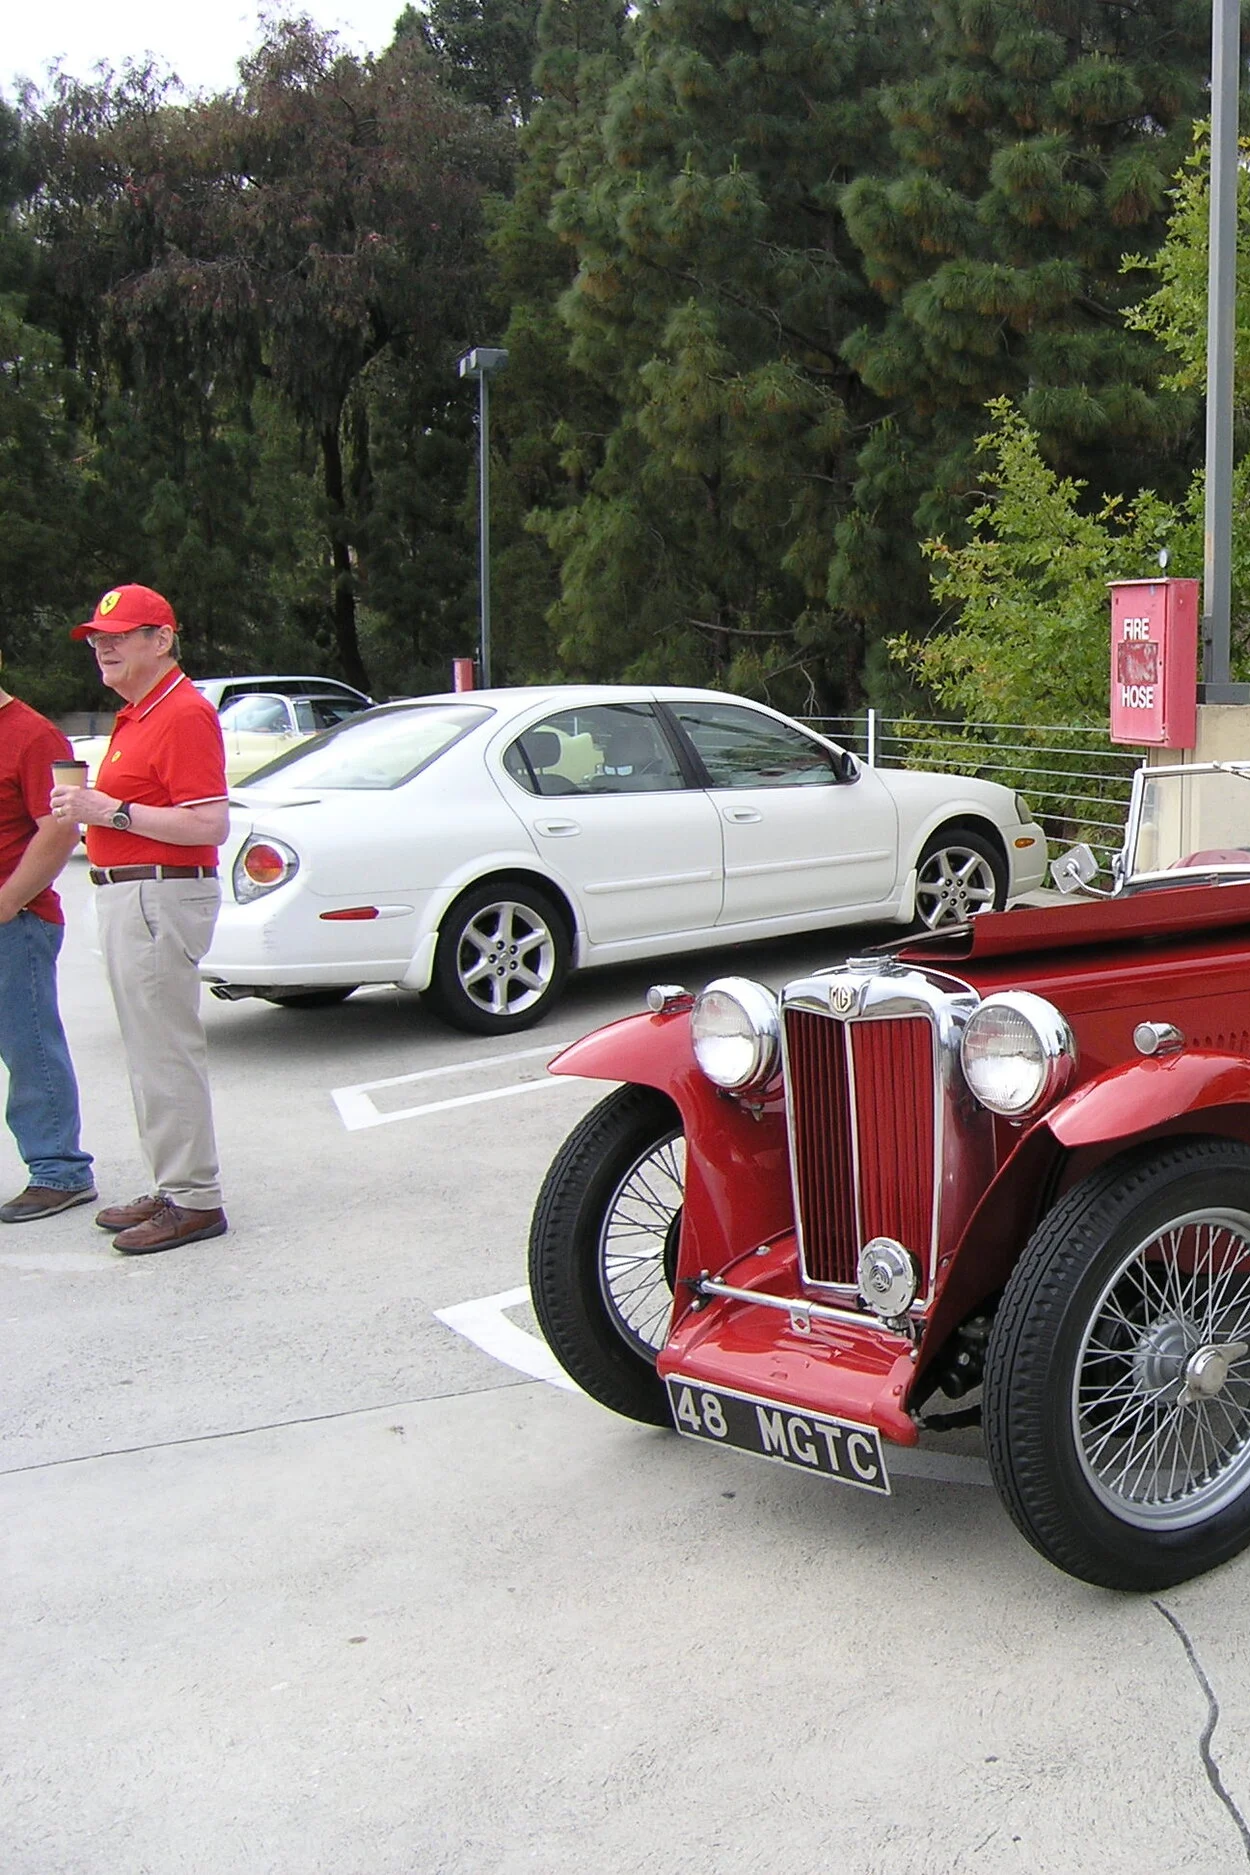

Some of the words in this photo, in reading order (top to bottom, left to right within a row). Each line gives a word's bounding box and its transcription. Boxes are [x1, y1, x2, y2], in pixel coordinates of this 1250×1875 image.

[1123, 617, 1150, 641] FIRE
[1121, 685, 1154, 709] HOSE
[832, 986, 851, 1011] MG
[677, 1386, 729, 1438] 48
[756, 1405, 878, 1481] MGTC
